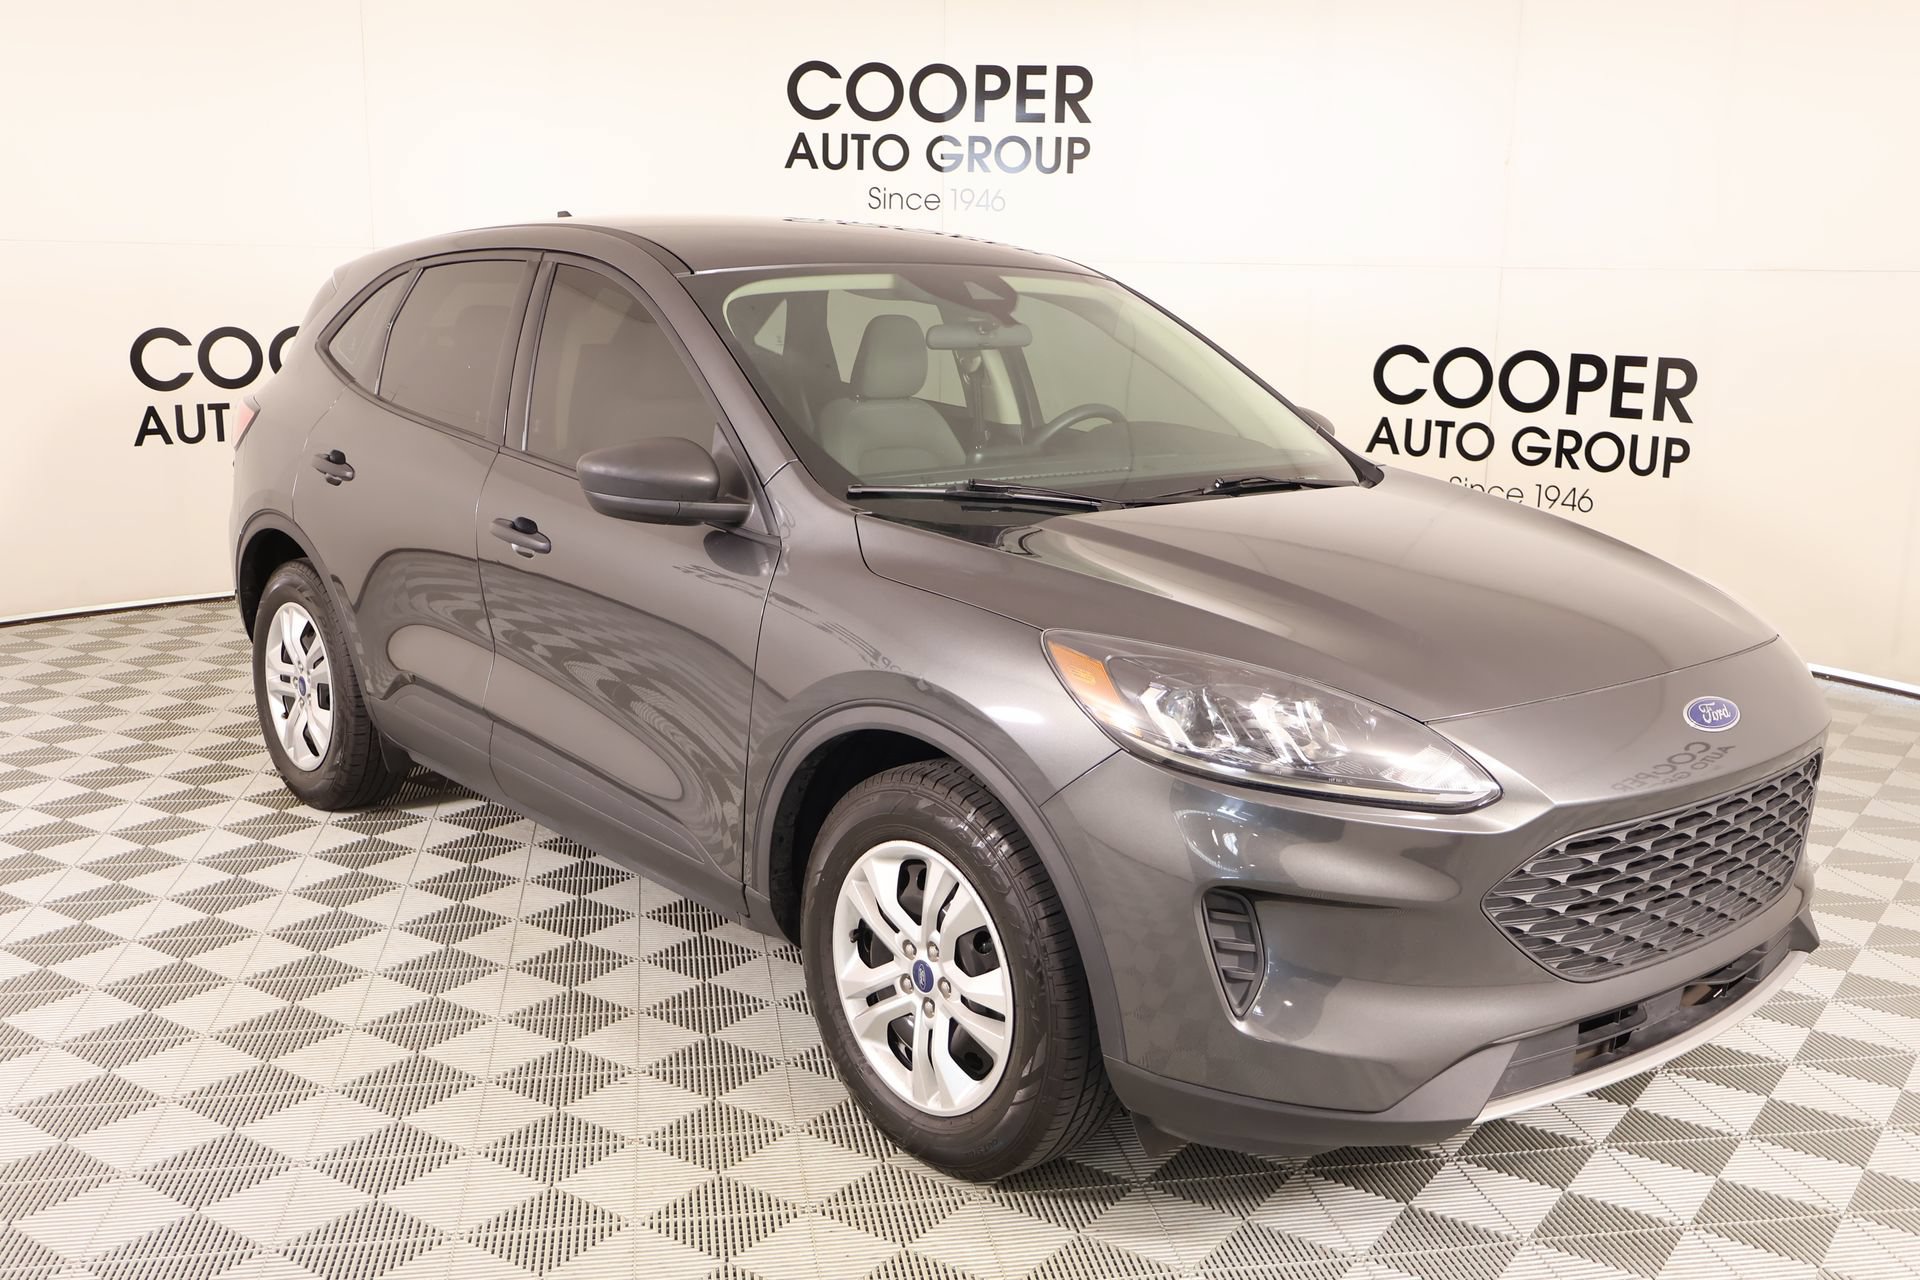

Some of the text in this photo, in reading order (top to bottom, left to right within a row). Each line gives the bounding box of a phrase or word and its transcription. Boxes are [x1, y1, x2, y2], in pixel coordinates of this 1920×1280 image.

[786, 60, 1094, 123] COOPER
[784, 132, 1091, 174] AUTO GROUP
[867, 186, 1006, 212] Since 1946
[1373, 344, 1698, 424] COOPER
[133, 402, 231, 447] AUT
[1365, 416, 1691, 479] AUTO GROUP
[1535, 484, 1594, 513] 1946
[1698, 702, 1731, 724] Ford
